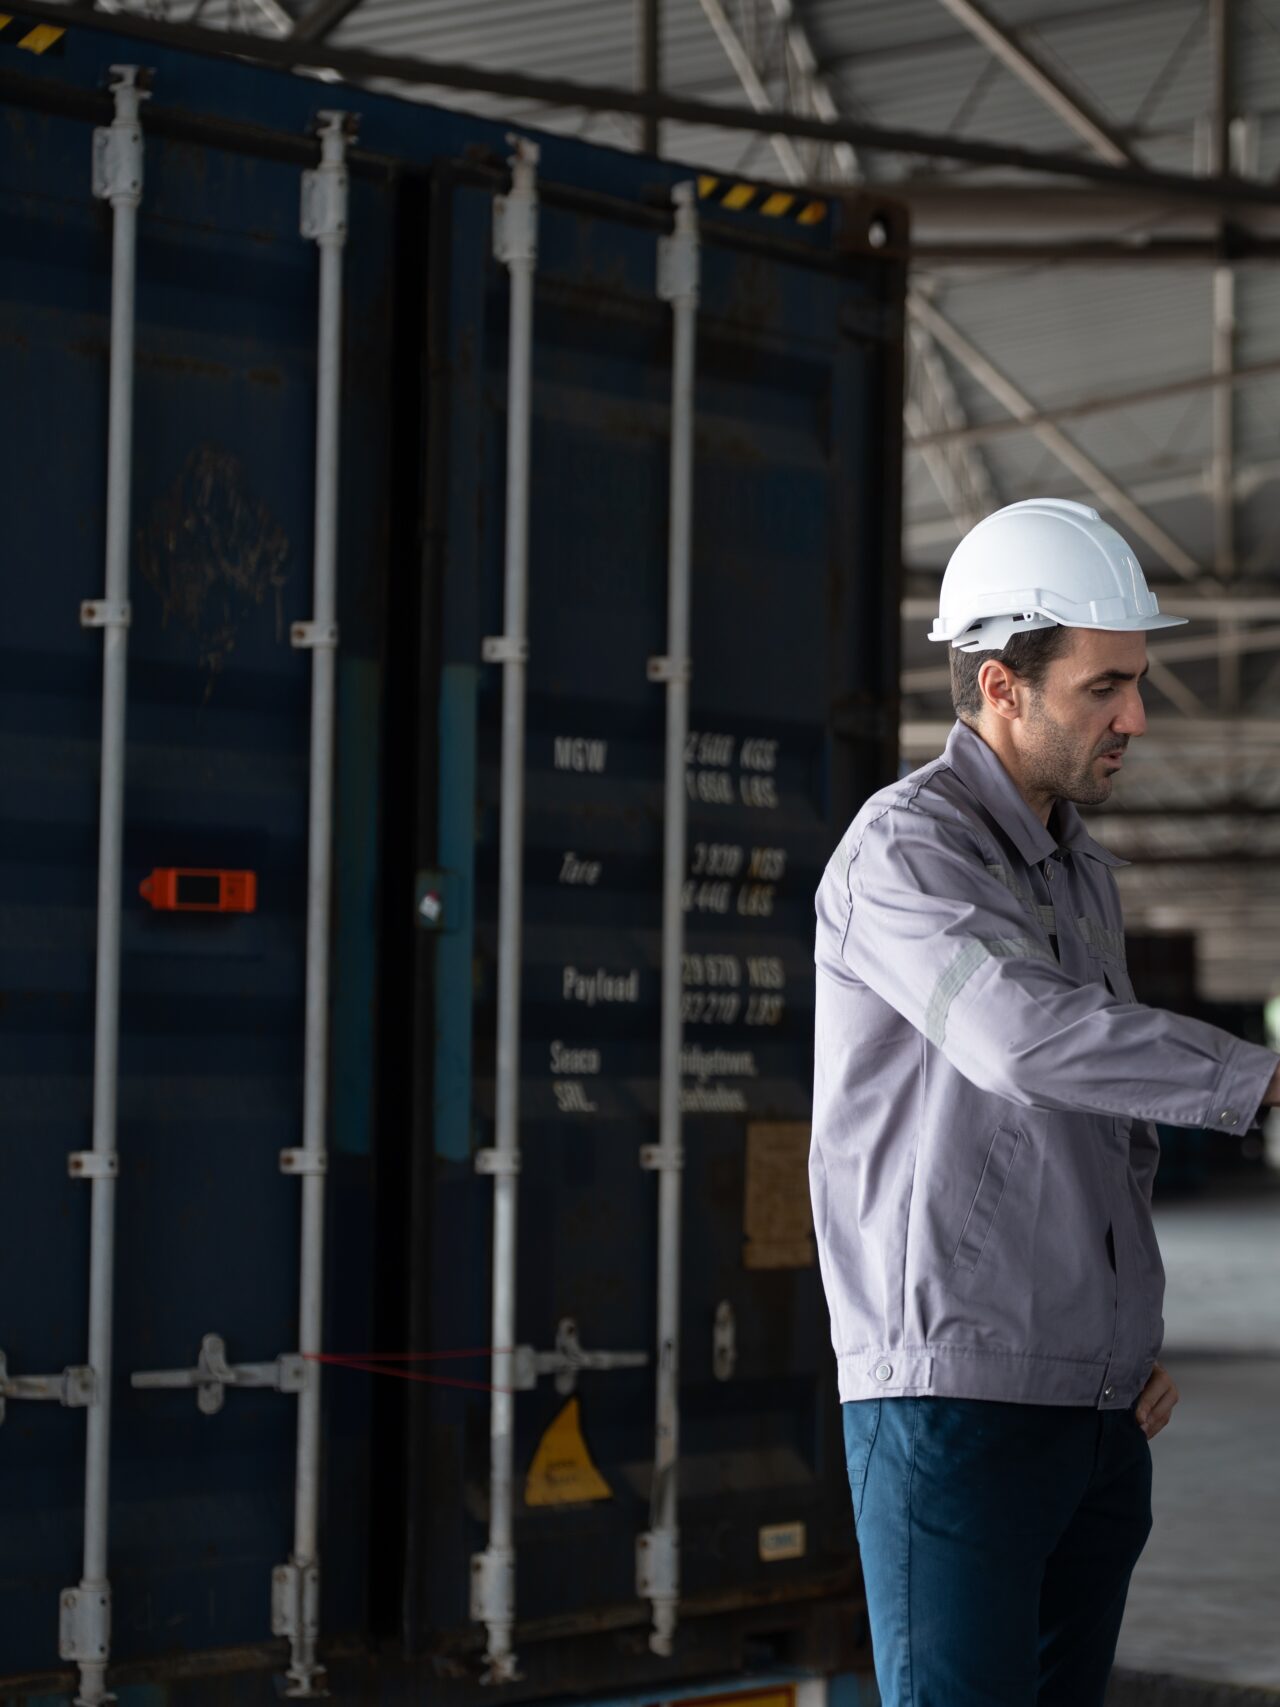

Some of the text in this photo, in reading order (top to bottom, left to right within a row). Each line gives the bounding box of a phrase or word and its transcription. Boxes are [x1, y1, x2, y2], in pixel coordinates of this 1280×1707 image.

[554, 736, 604, 772] MGW
[560, 851, 600, 885] Tare
[564, 966, 636, 1006] Payload
